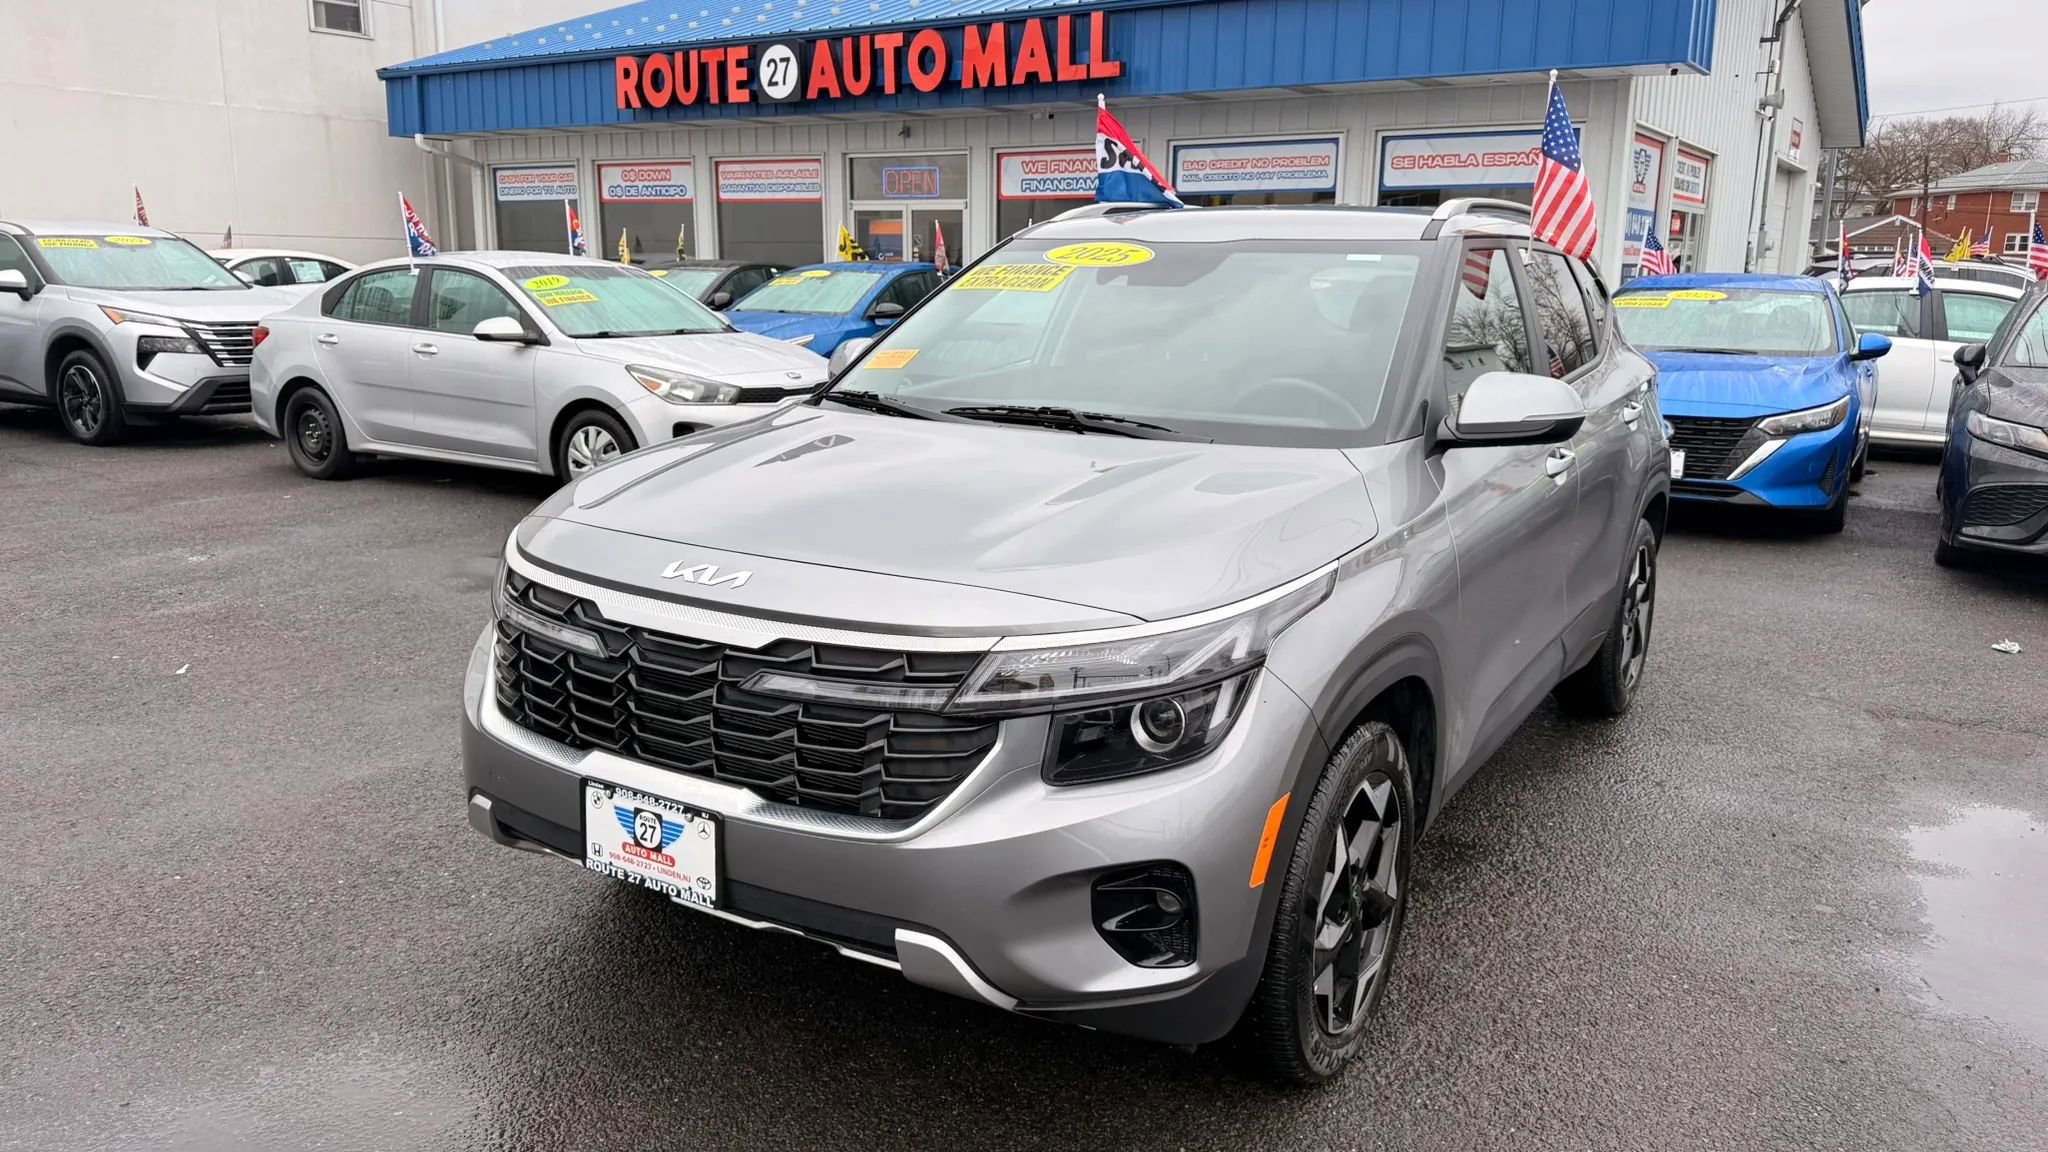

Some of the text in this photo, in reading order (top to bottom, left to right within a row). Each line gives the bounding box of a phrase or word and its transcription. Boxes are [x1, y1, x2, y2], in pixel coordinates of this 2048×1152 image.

[615, 11, 1121, 109] ROUTE 27 AUTO MALL
[1021, 158, 1098, 174] WE FINANC
[1183, 155, 1331, 171] BAD CREDIT NO PROBLEM
[1391, 148, 1542, 169] SE HABLA ESPAÑ
[499, 172, 575, 184] CASH FOR YOUR CAR
[638, 169, 671, 181] DOWN
[886, 171, 936, 194] OPEN
[1182, 173, 1202, 182] MAL
[1241, 172, 1256, 181] NO
[1256, 171, 1276, 180] HAY
[1277, 169, 1329, 179] PROBLEMA
[499, 185, 577, 196] DINERO POR TU AUTO
[624, 185, 640, 197] DE
[640, 184, 687, 197] ANTICIPO
[1021, 178, 1098, 192] FINANCIAM
[1055, 247, 1140, 263] 2025
[970, 265, 1072, 276] WE FINANCE
[532, 276, 560, 289] 2019
[960, 276, 1055, 288] EXTRA CLEAN
[660, 560, 753, 589] KIA
[588, 780, 604, 789] Linden
[615, 787, 684, 814] 908-648-2727
[639, 814, 656, 825] ROUTE
[701, 811, 709, 819] NJ
[640, 822, 656, 843] 27
[608, 851, 652, 871] 908-648-2727
[625, 845, 673, 865] AUTO MALL
[586, 859, 714, 908] ROUTE 27 AUTO MALL
